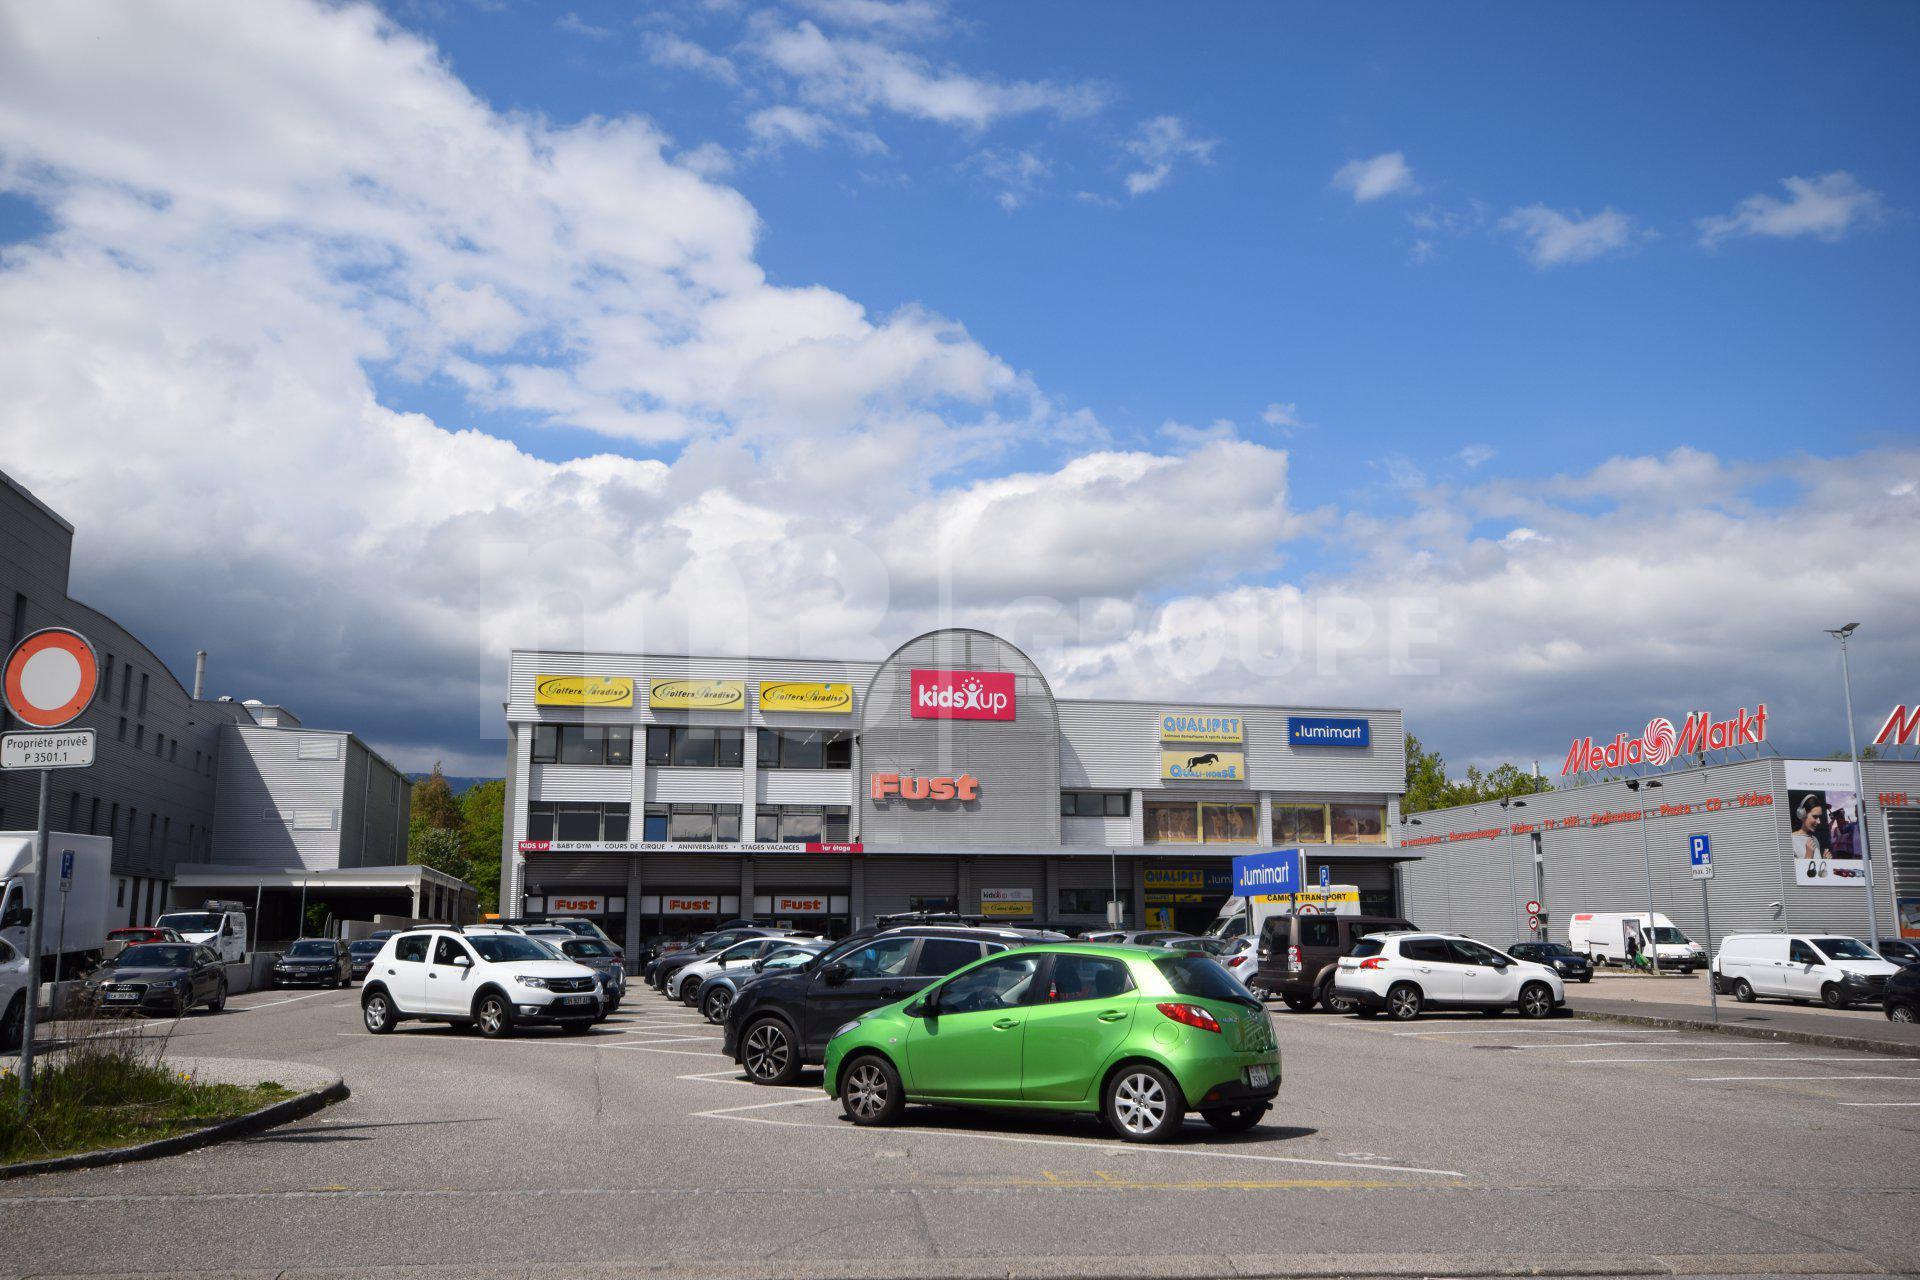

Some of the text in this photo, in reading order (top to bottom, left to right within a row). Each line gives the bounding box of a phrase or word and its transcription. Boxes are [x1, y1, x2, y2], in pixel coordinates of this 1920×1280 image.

[546, 682, 624, 696] Golfers Paradise
[660, 685, 736, 699] Golfers Paradise
[769, 687, 843, 702] Golfers Paradise
[919, 684, 1008, 714] kids up
[1163, 716, 1239, 733] QUALIPET
[7, 736, 88, 750] Propriété privée
[1561, 703, 1769, 777] Media Markt
[25, 752, 67, 763] P 3501.1
[871, 773, 979, 801] Fust
[1706, 797, 1722, 812] CD
[604, 842, 628, 850] COURS
[833, 844, 851, 852] étage
[555, 900, 597, 910] Fust
[669, 900, 711, 910] Fust
[780, 900, 821, 910] Fust
